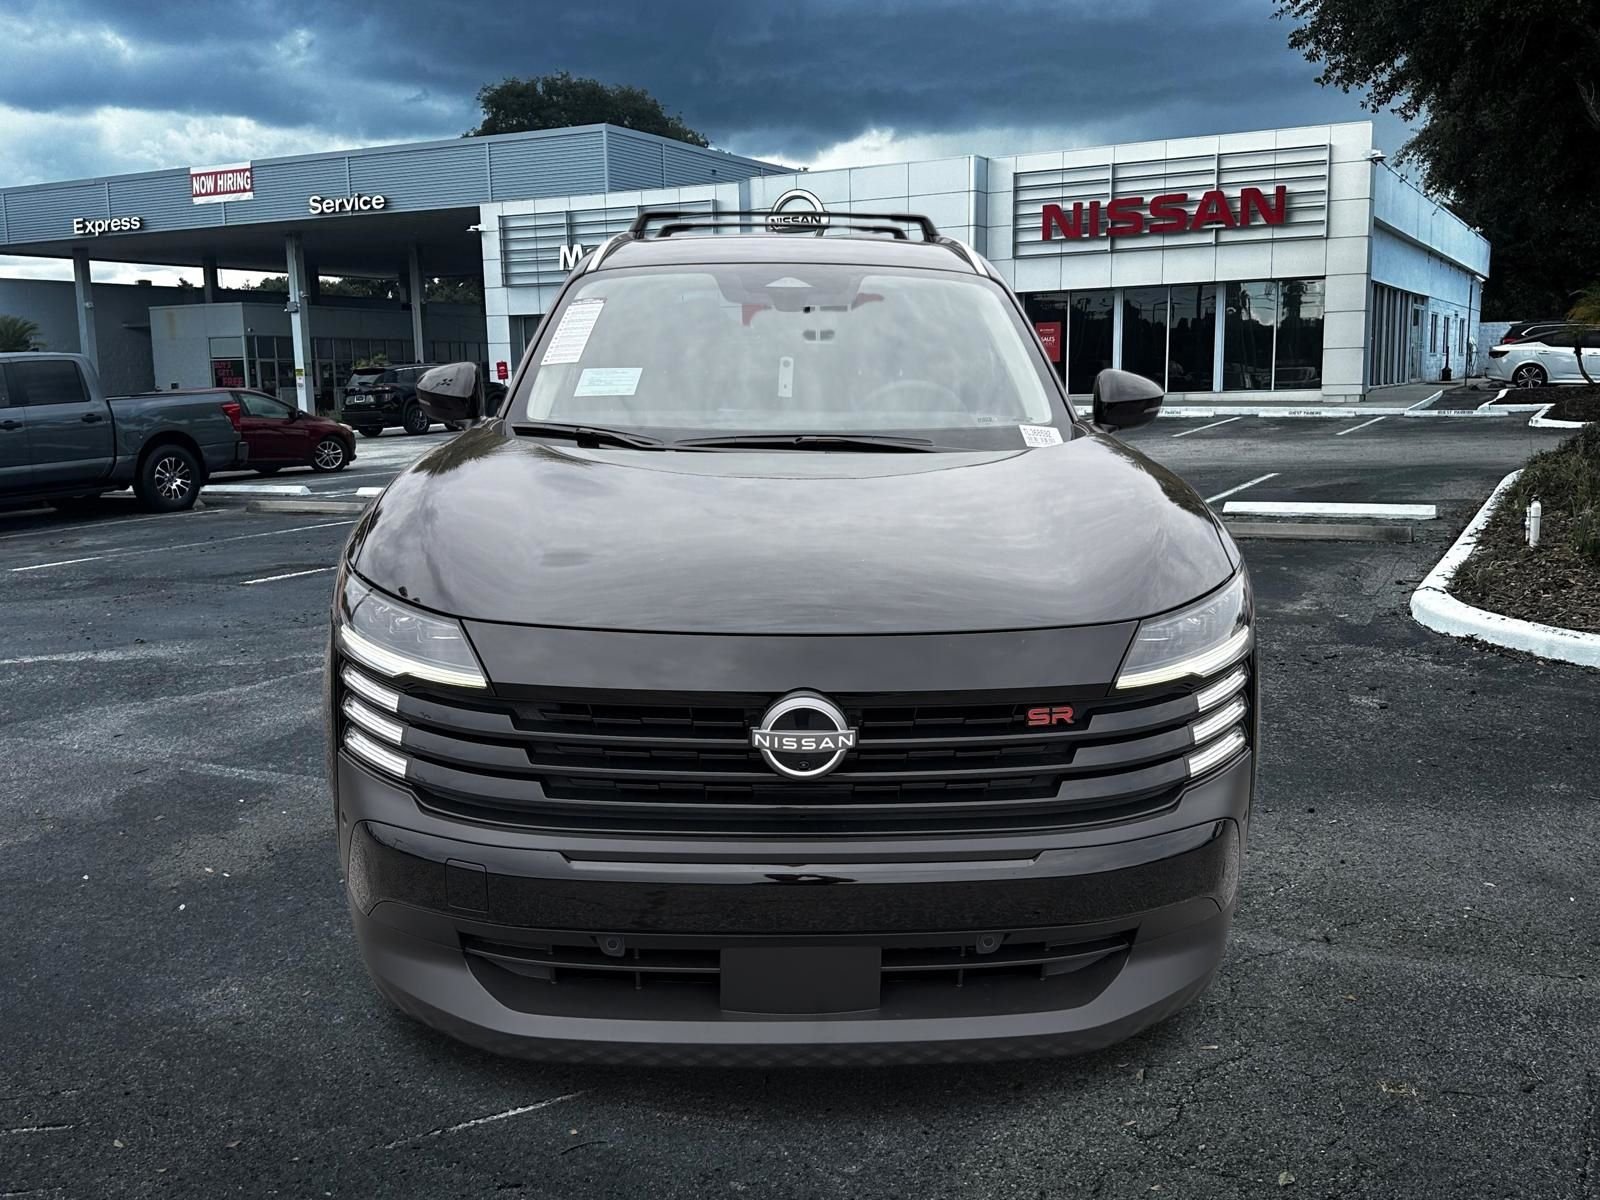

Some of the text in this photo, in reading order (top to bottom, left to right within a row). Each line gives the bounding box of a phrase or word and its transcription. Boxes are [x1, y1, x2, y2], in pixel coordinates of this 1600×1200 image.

[192, 170, 251, 195] NOW HIRING
[308, 193, 385, 215] Service
[1041, 185, 1287, 241] NISSAN
[73, 215, 141, 236] Express
[1027, 706, 1075, 726] SR
[754, 733, 854, 750] NISSAN
